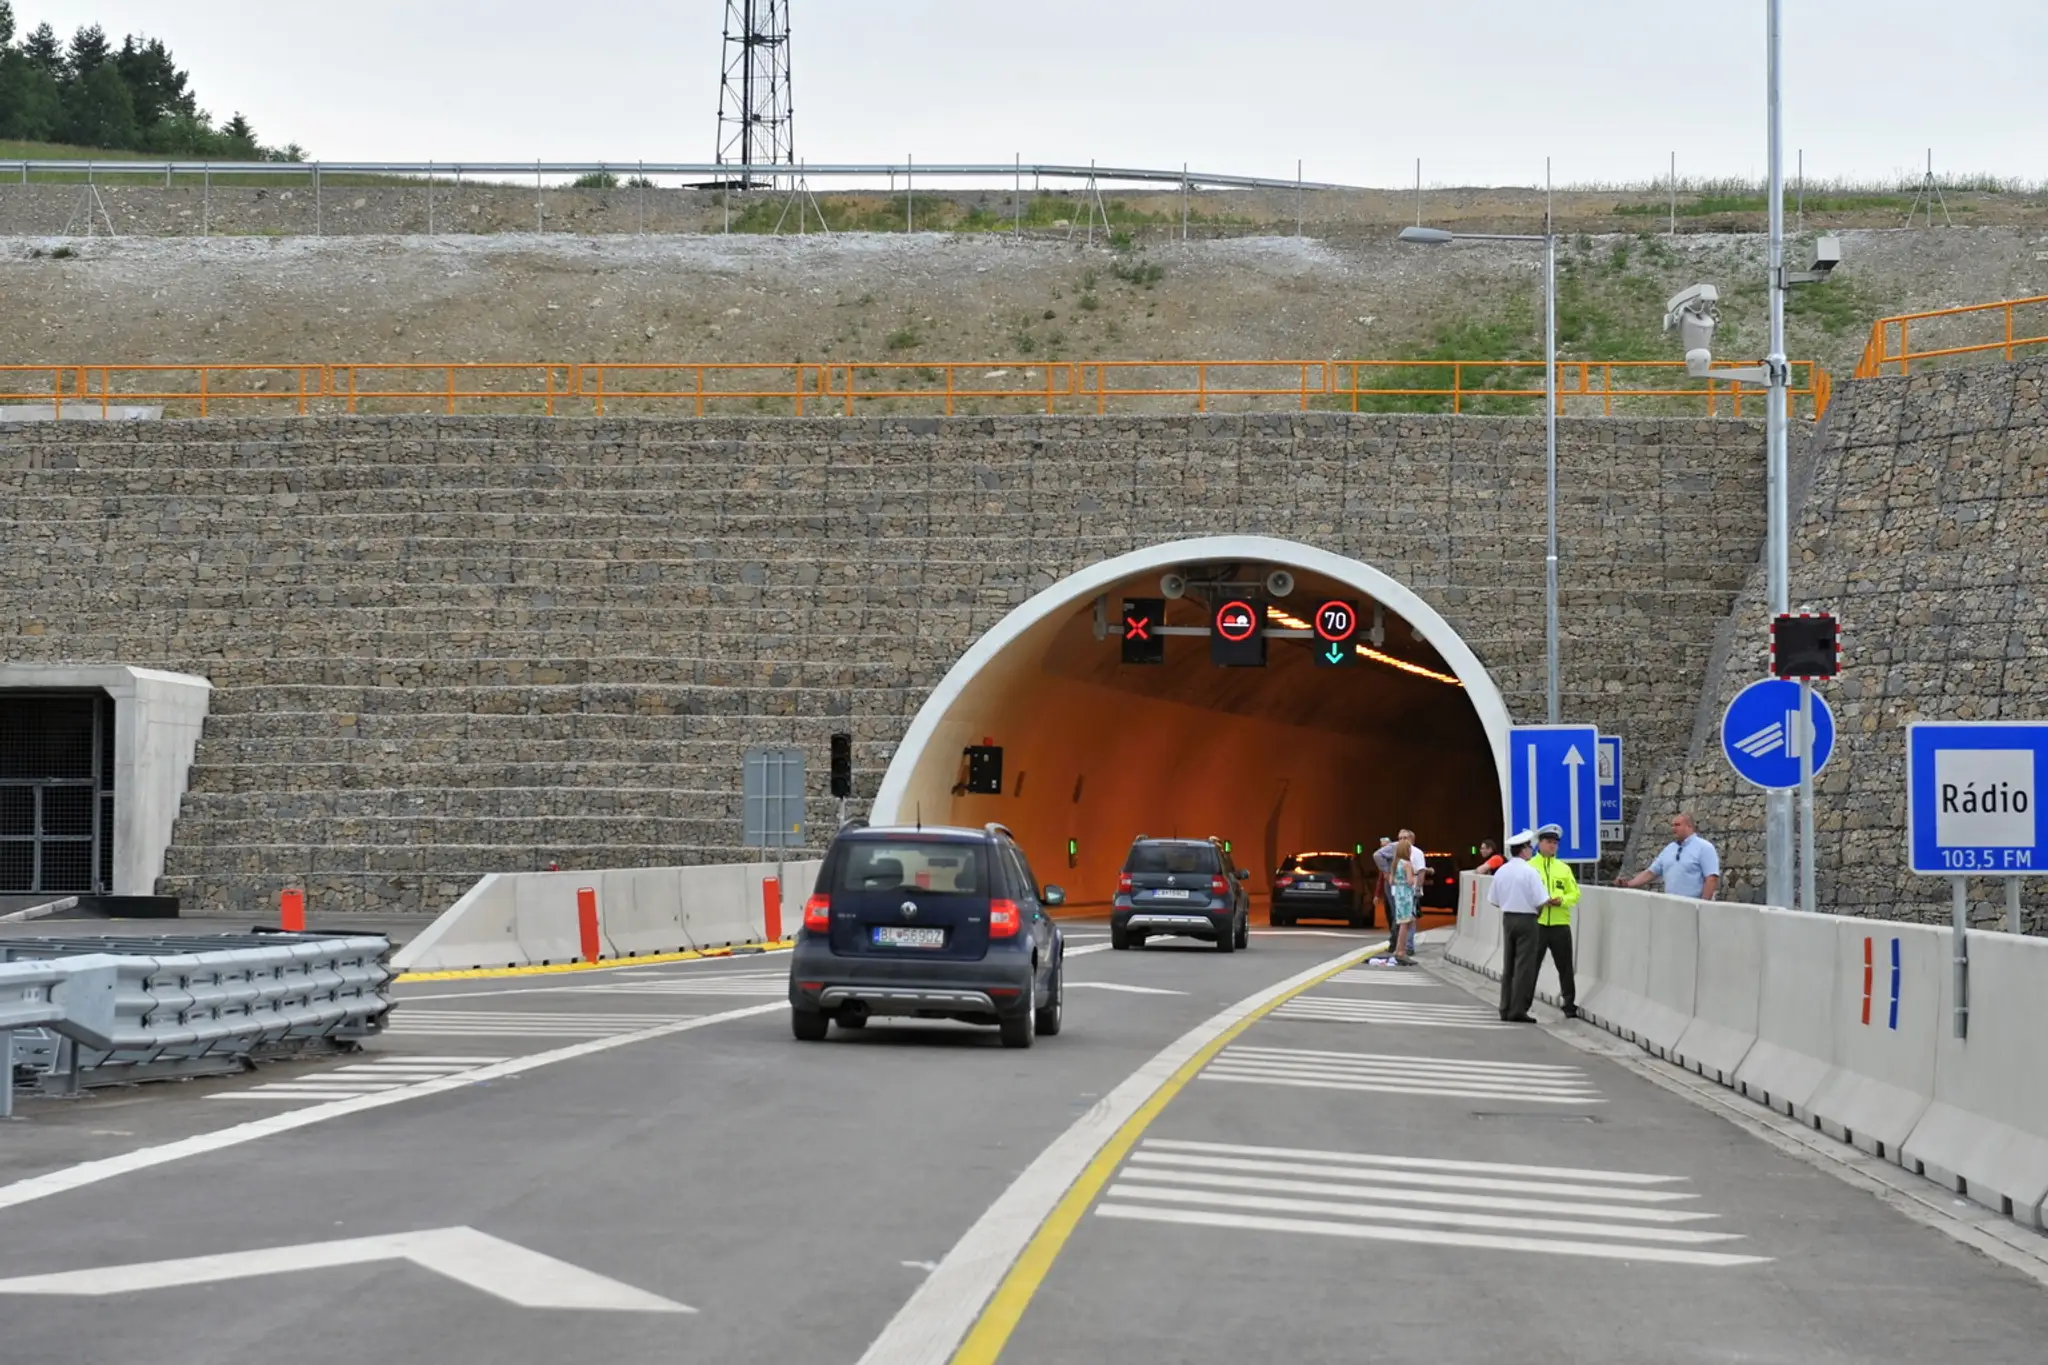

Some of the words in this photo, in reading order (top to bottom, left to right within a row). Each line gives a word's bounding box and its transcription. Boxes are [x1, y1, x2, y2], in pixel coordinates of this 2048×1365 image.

[1324, 611, 1347, 630] 70
[1942, 781, 2028, 814] Rádio
[1941, 849, 1995, 870] 103,5
[2003, 849, 2032, 868] FM
